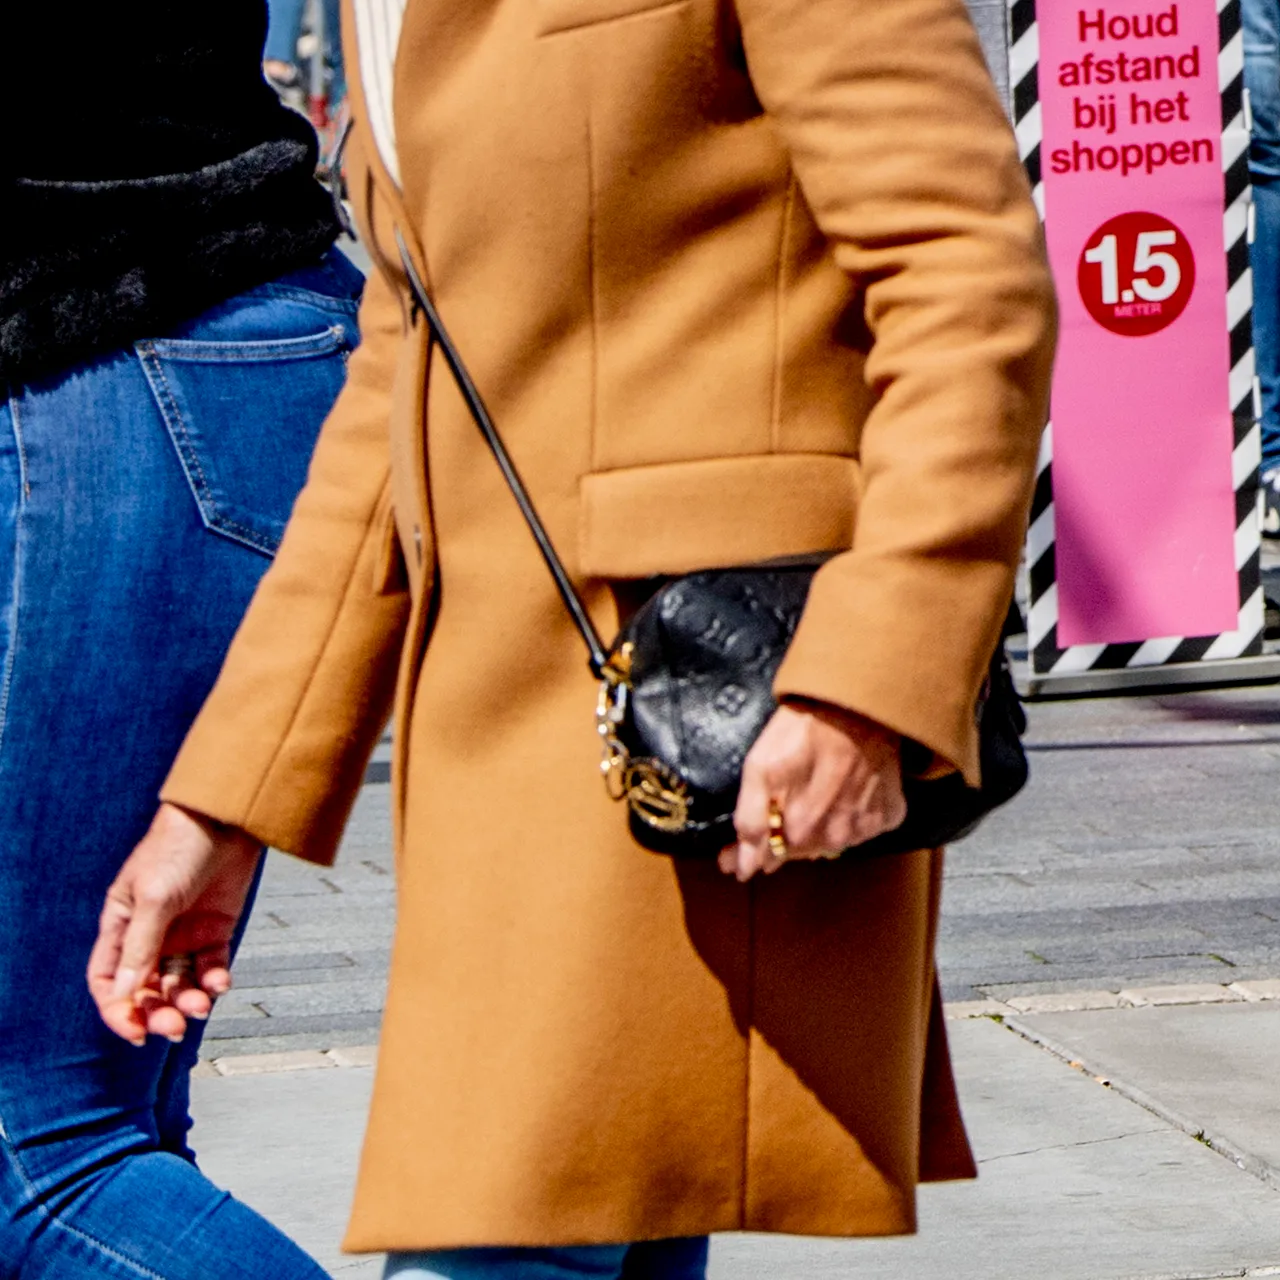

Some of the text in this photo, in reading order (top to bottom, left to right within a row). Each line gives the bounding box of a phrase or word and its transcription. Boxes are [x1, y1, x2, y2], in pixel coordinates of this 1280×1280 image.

[1078, 4, 1178, 42] Houd
[1058, 46, 1199, 87] afstand
[1074, 92, 1189, 134] bij het
[1051, 138, 1213, 176] shoppen
[1085, 230, 1181, 304] 1.5
[1114, 302, 1161, 317] METER
